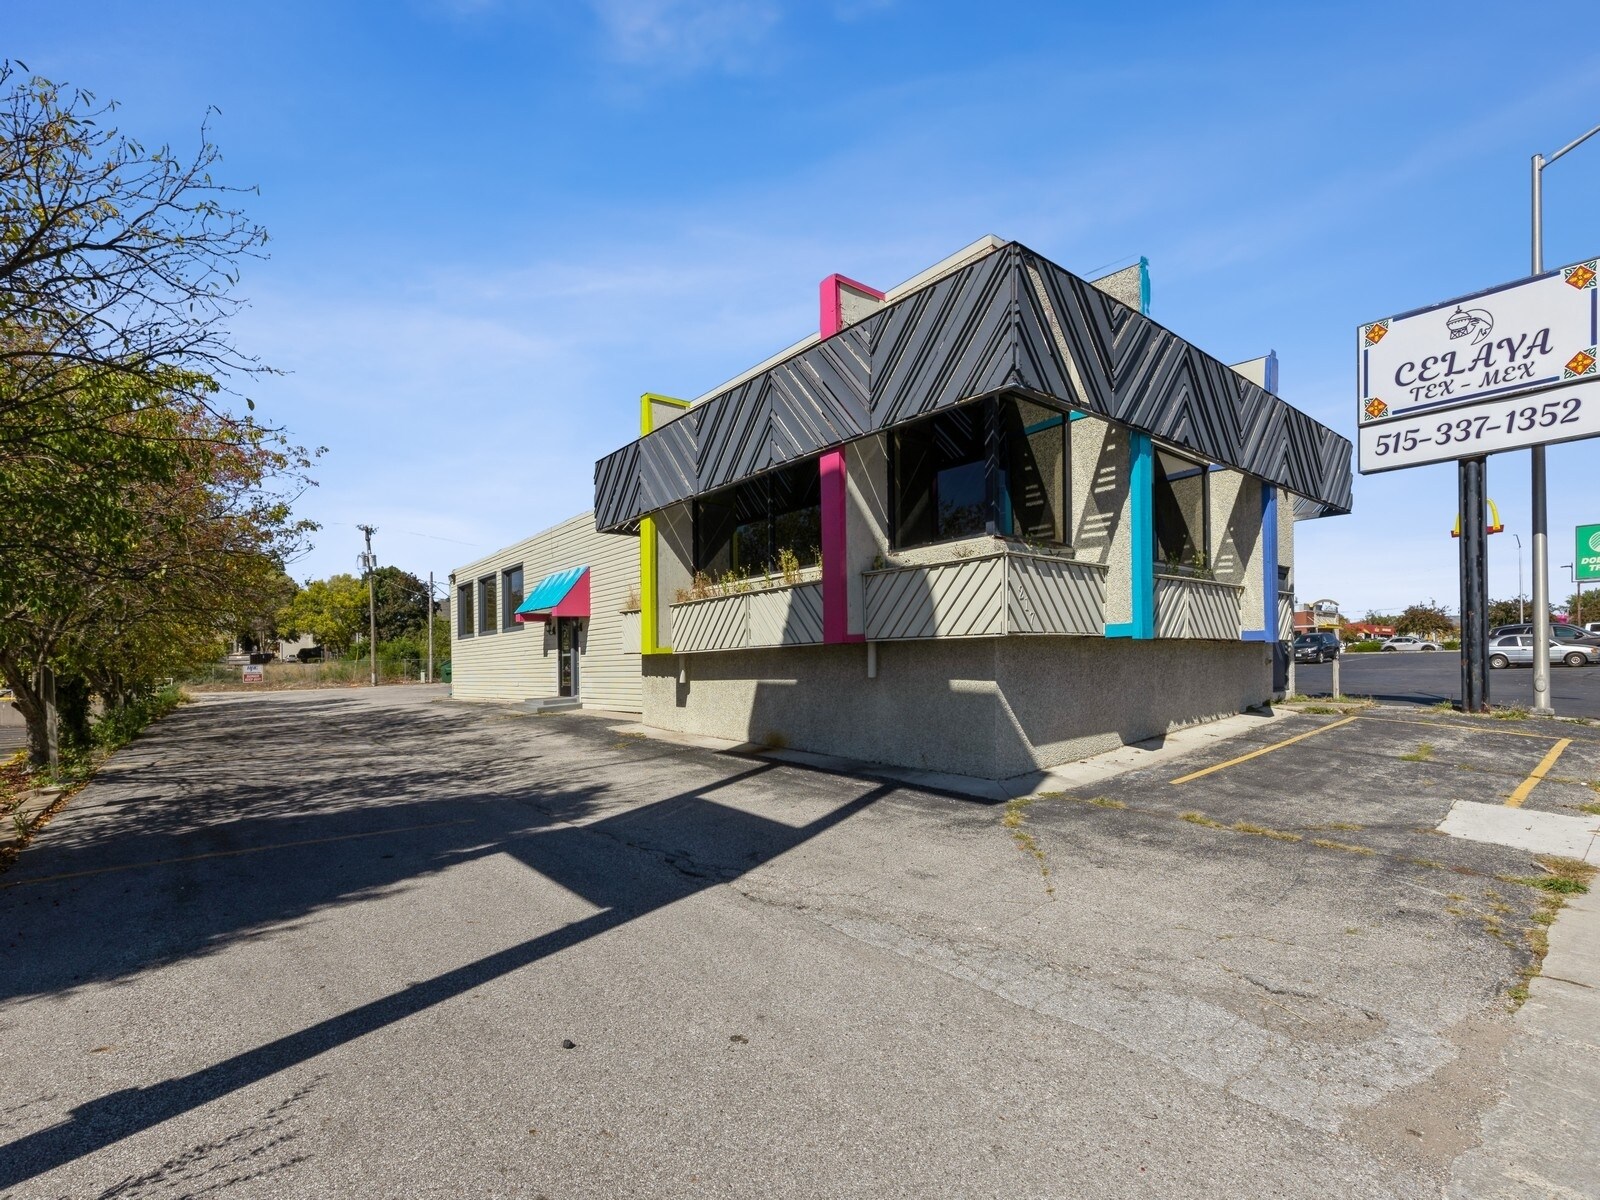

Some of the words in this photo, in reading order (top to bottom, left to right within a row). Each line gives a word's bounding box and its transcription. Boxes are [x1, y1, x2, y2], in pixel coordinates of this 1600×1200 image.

[1394, 327, 1554, 387] CELAYA
[1409, 379, 1455, 402] TEX
[1478, 361, 1536, 388] MEX
[1375, 398, 1582, 456] 515-337-1352
